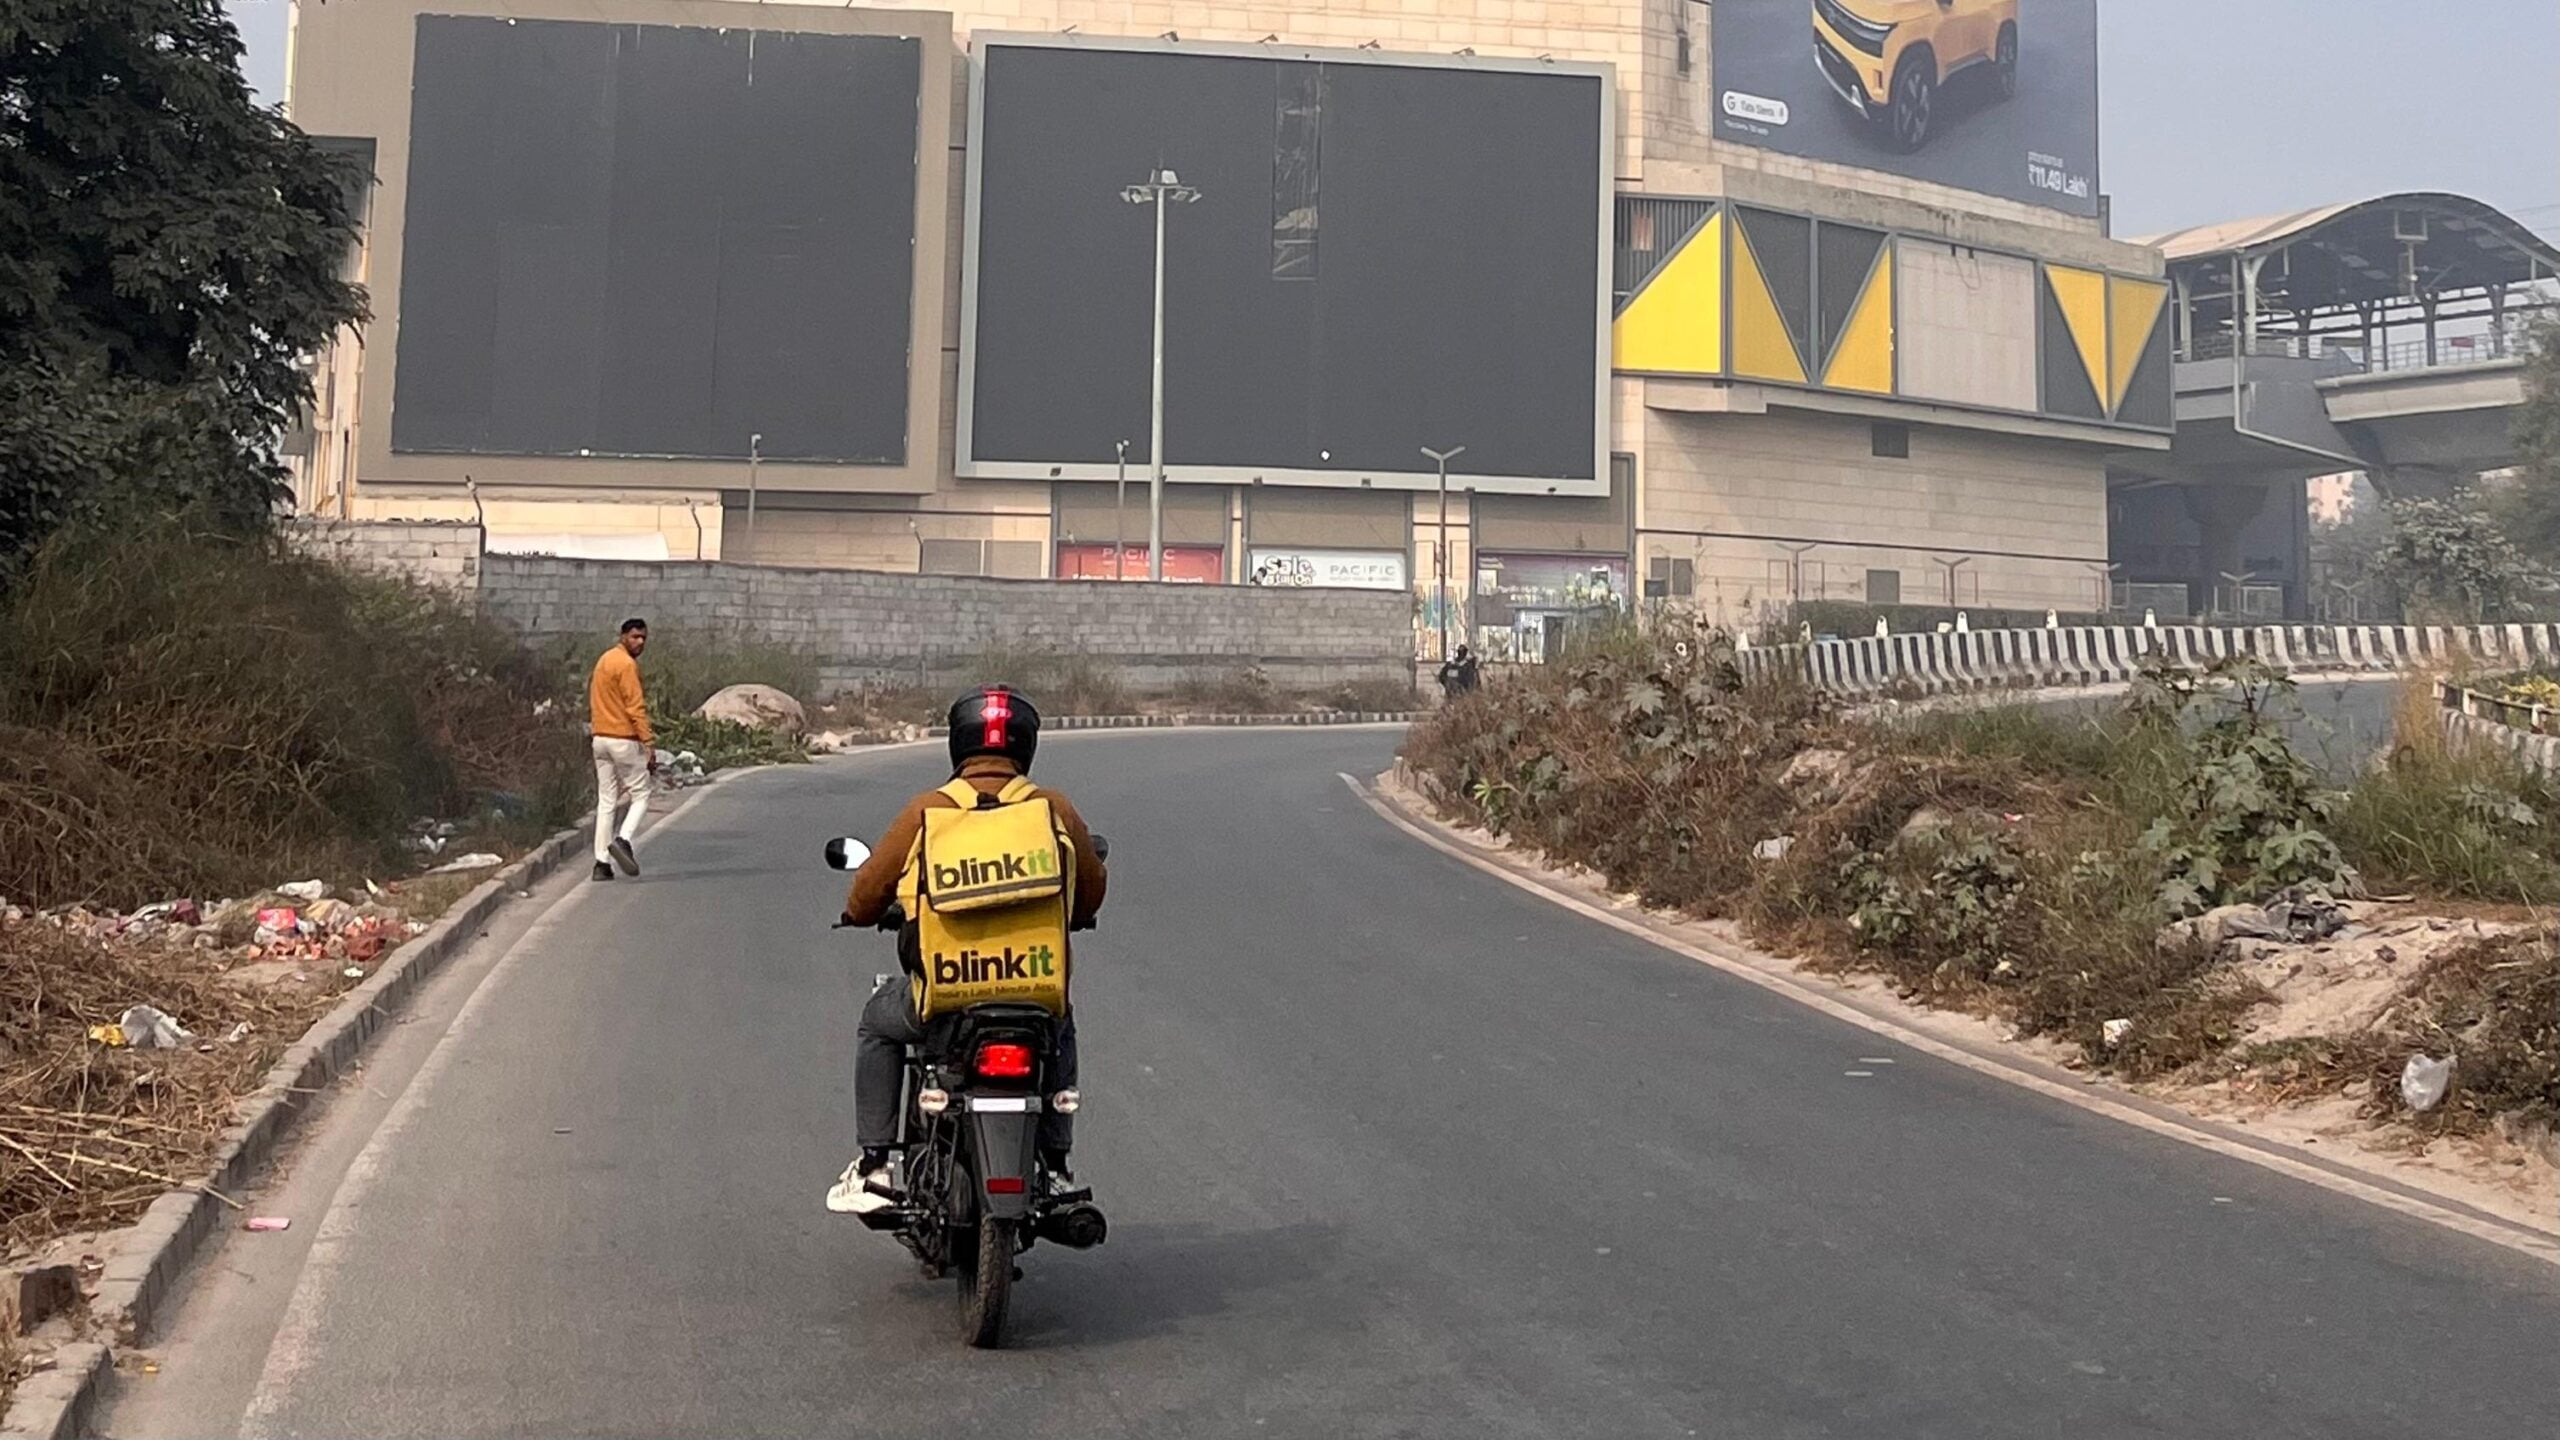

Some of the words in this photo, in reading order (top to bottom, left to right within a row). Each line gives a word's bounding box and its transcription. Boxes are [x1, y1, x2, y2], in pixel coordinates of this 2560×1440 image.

[1264, 555, 1313, 577] Sale
[1330, 564, 1395, 576] PACIFIC
[934, 848, 1053, 891] blinkit
[934, 944, 1055, 985] blinkit
